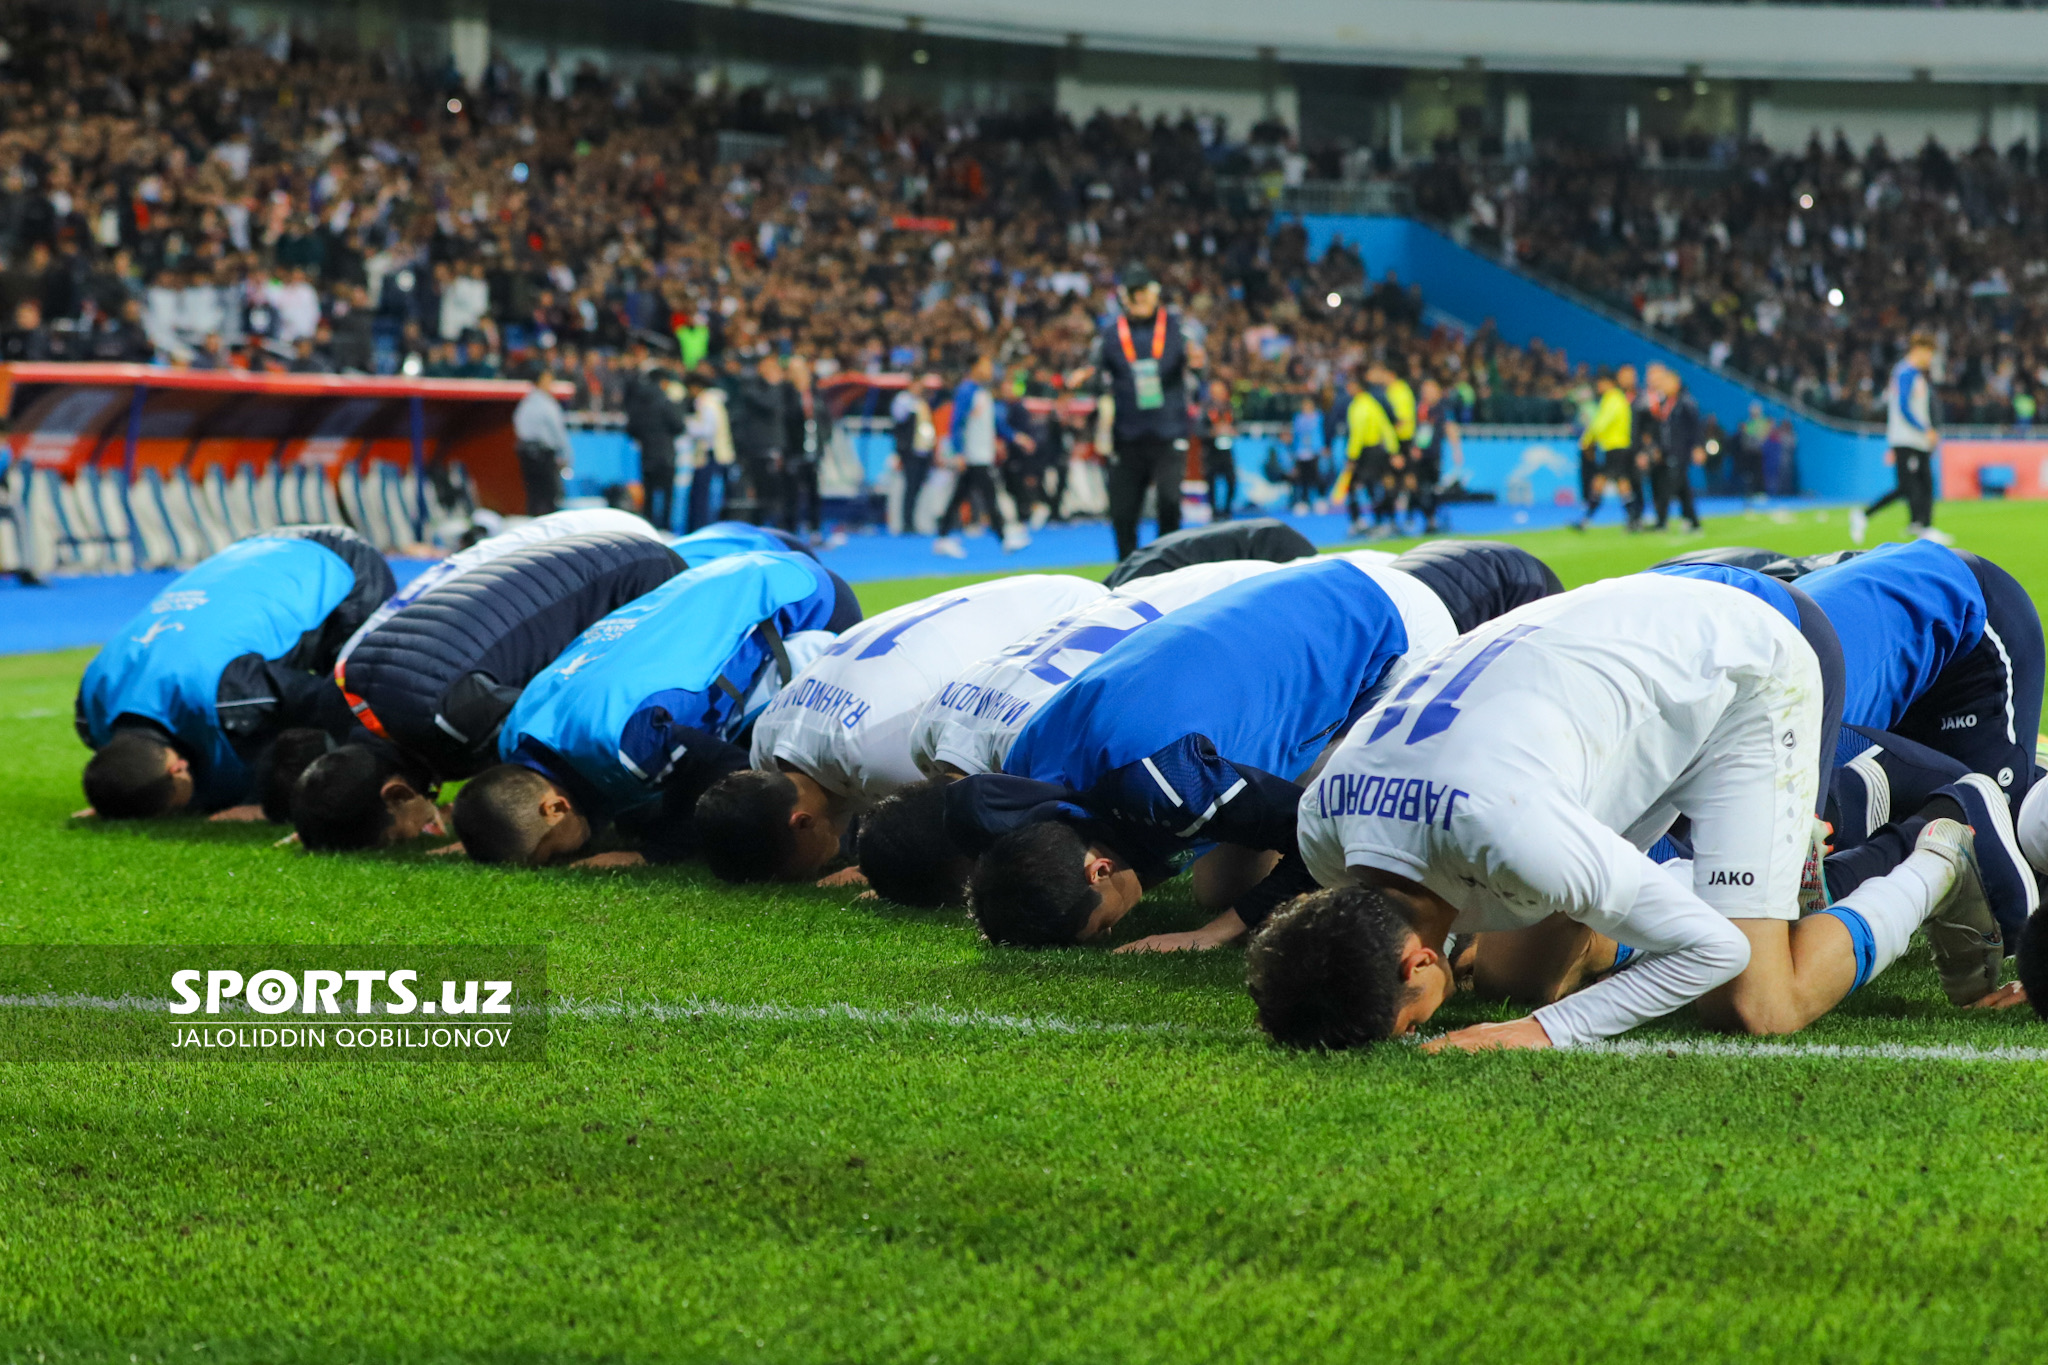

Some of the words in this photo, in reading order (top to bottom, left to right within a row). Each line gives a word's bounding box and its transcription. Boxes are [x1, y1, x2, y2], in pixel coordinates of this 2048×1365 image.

[1941, 714, 1978, 731] JAKO
[1316, 774, 1470, 831] JABBOROV
[1708, 871, 1755, 886] JAKO
